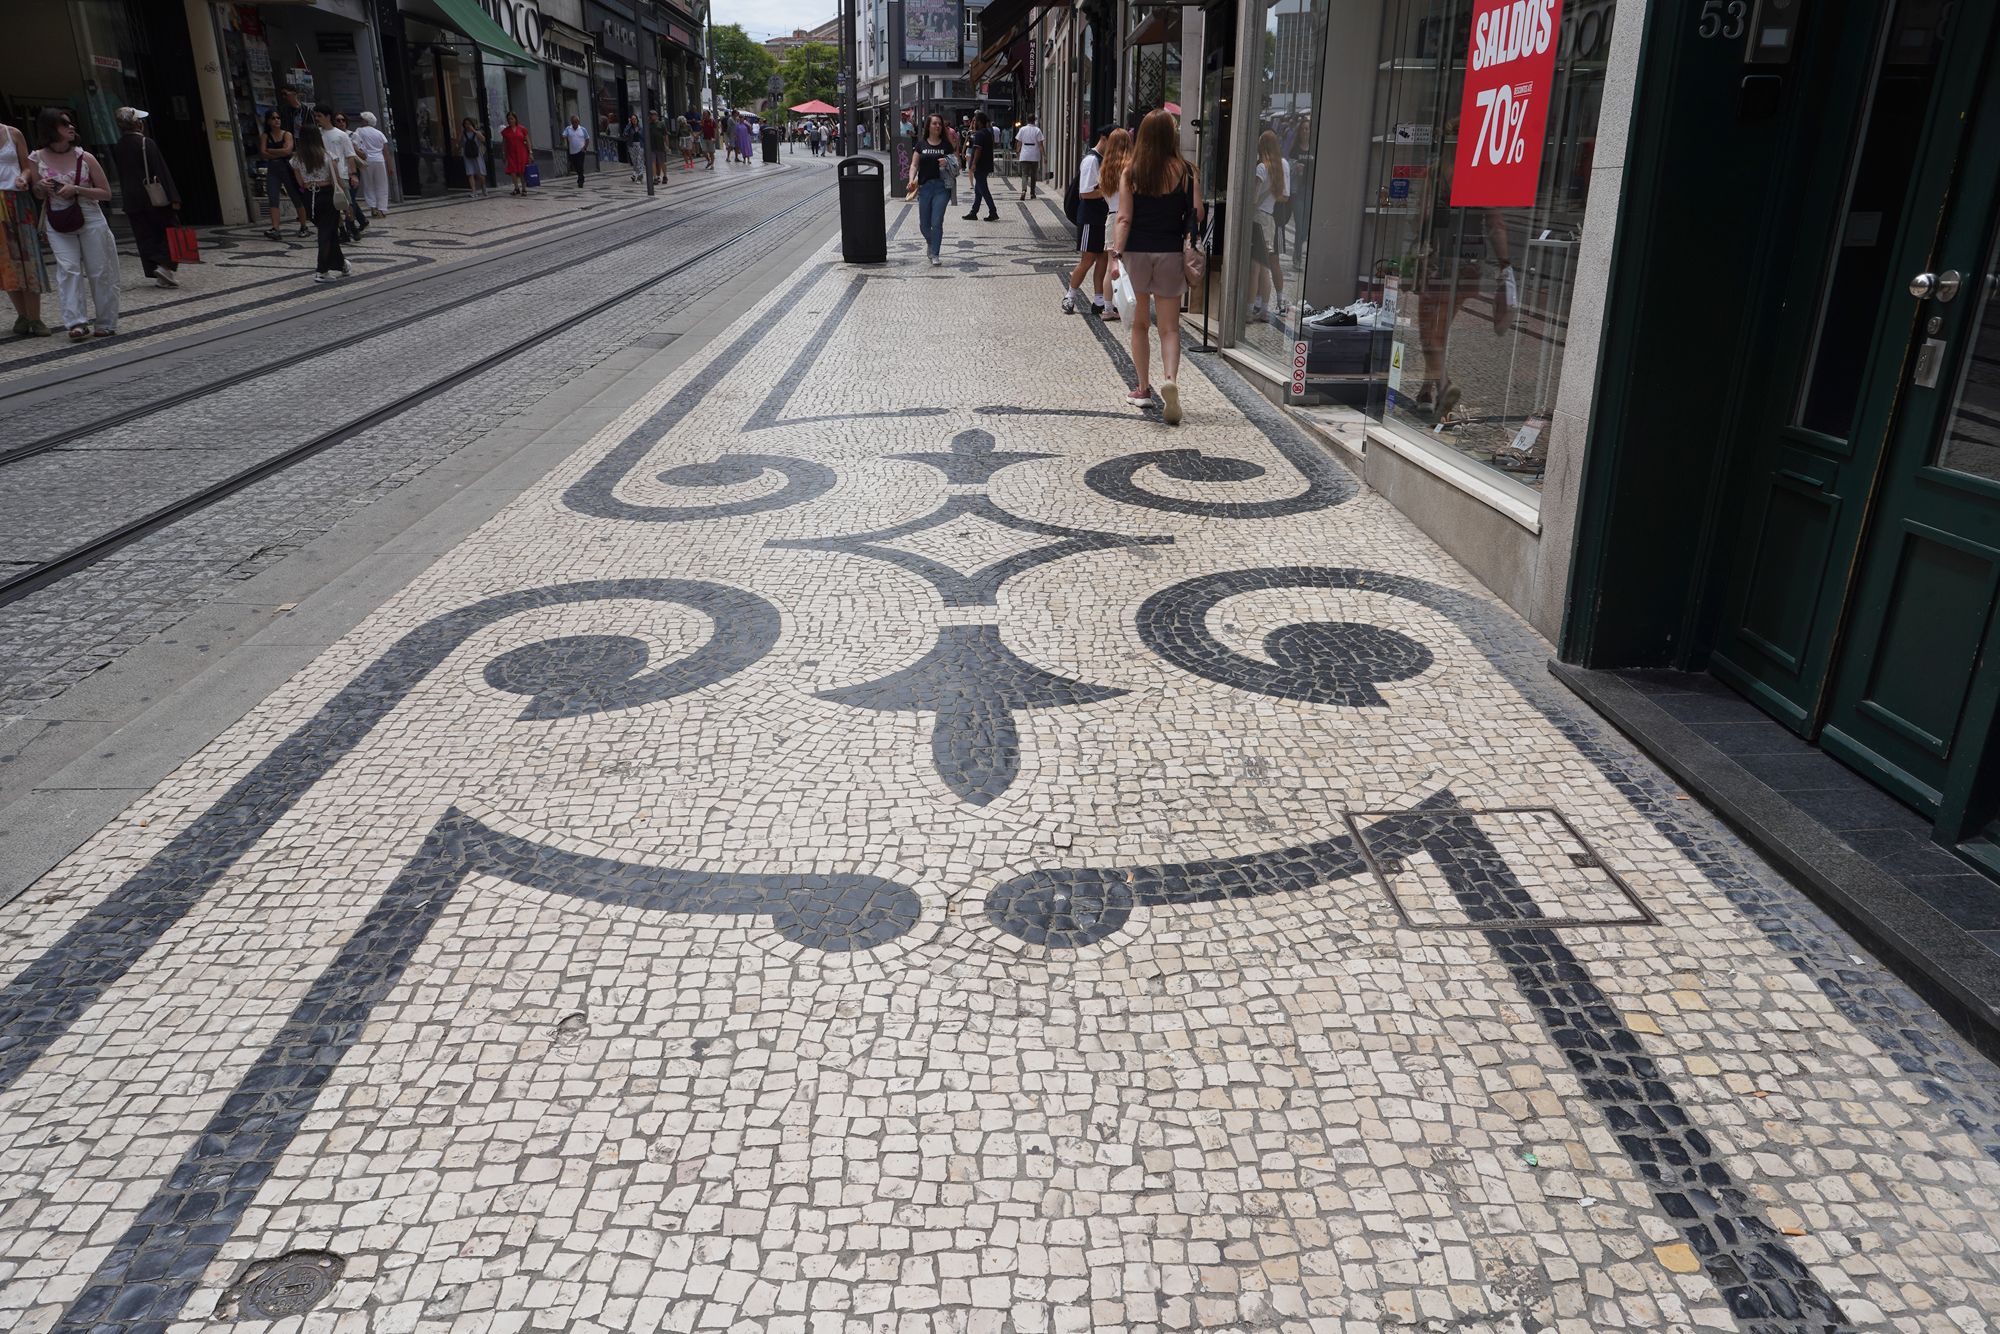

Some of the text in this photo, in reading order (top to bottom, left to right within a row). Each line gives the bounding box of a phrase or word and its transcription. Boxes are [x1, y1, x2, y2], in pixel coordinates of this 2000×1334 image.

[1473, 0, 1554, 71] SALDOS
[1699, 0, 1747, 39] 53
[1028, 42, 1036, 89] MARBELLA
[1471, 84, 1529, 167] 70%
